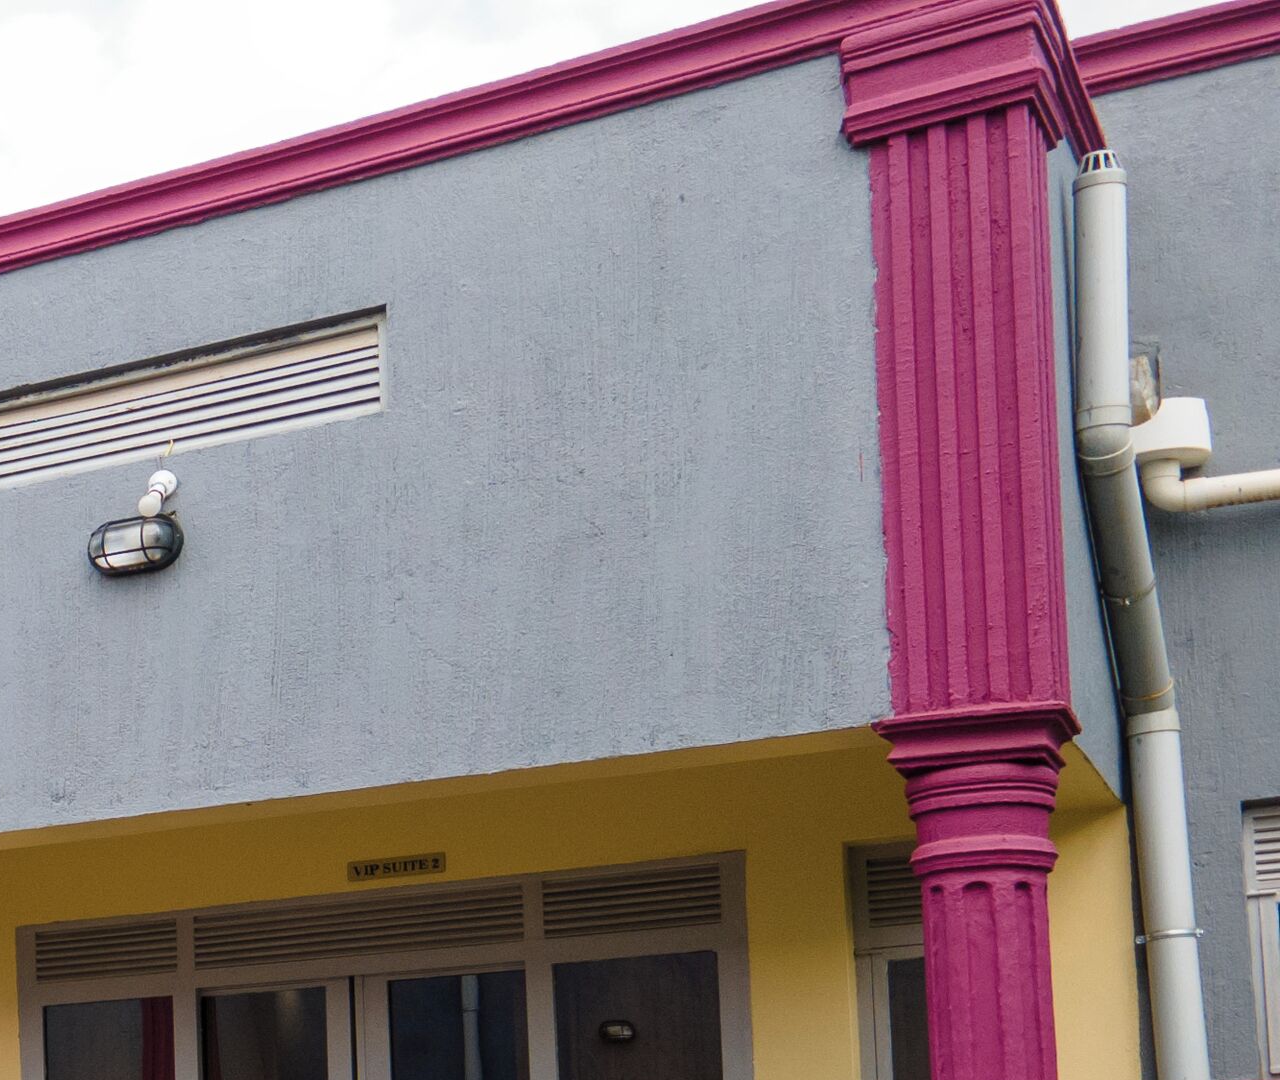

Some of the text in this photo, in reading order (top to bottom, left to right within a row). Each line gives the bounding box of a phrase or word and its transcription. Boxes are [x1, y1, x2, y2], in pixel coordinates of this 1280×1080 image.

[353, 858, 440, 877] VIP SUITE 2
